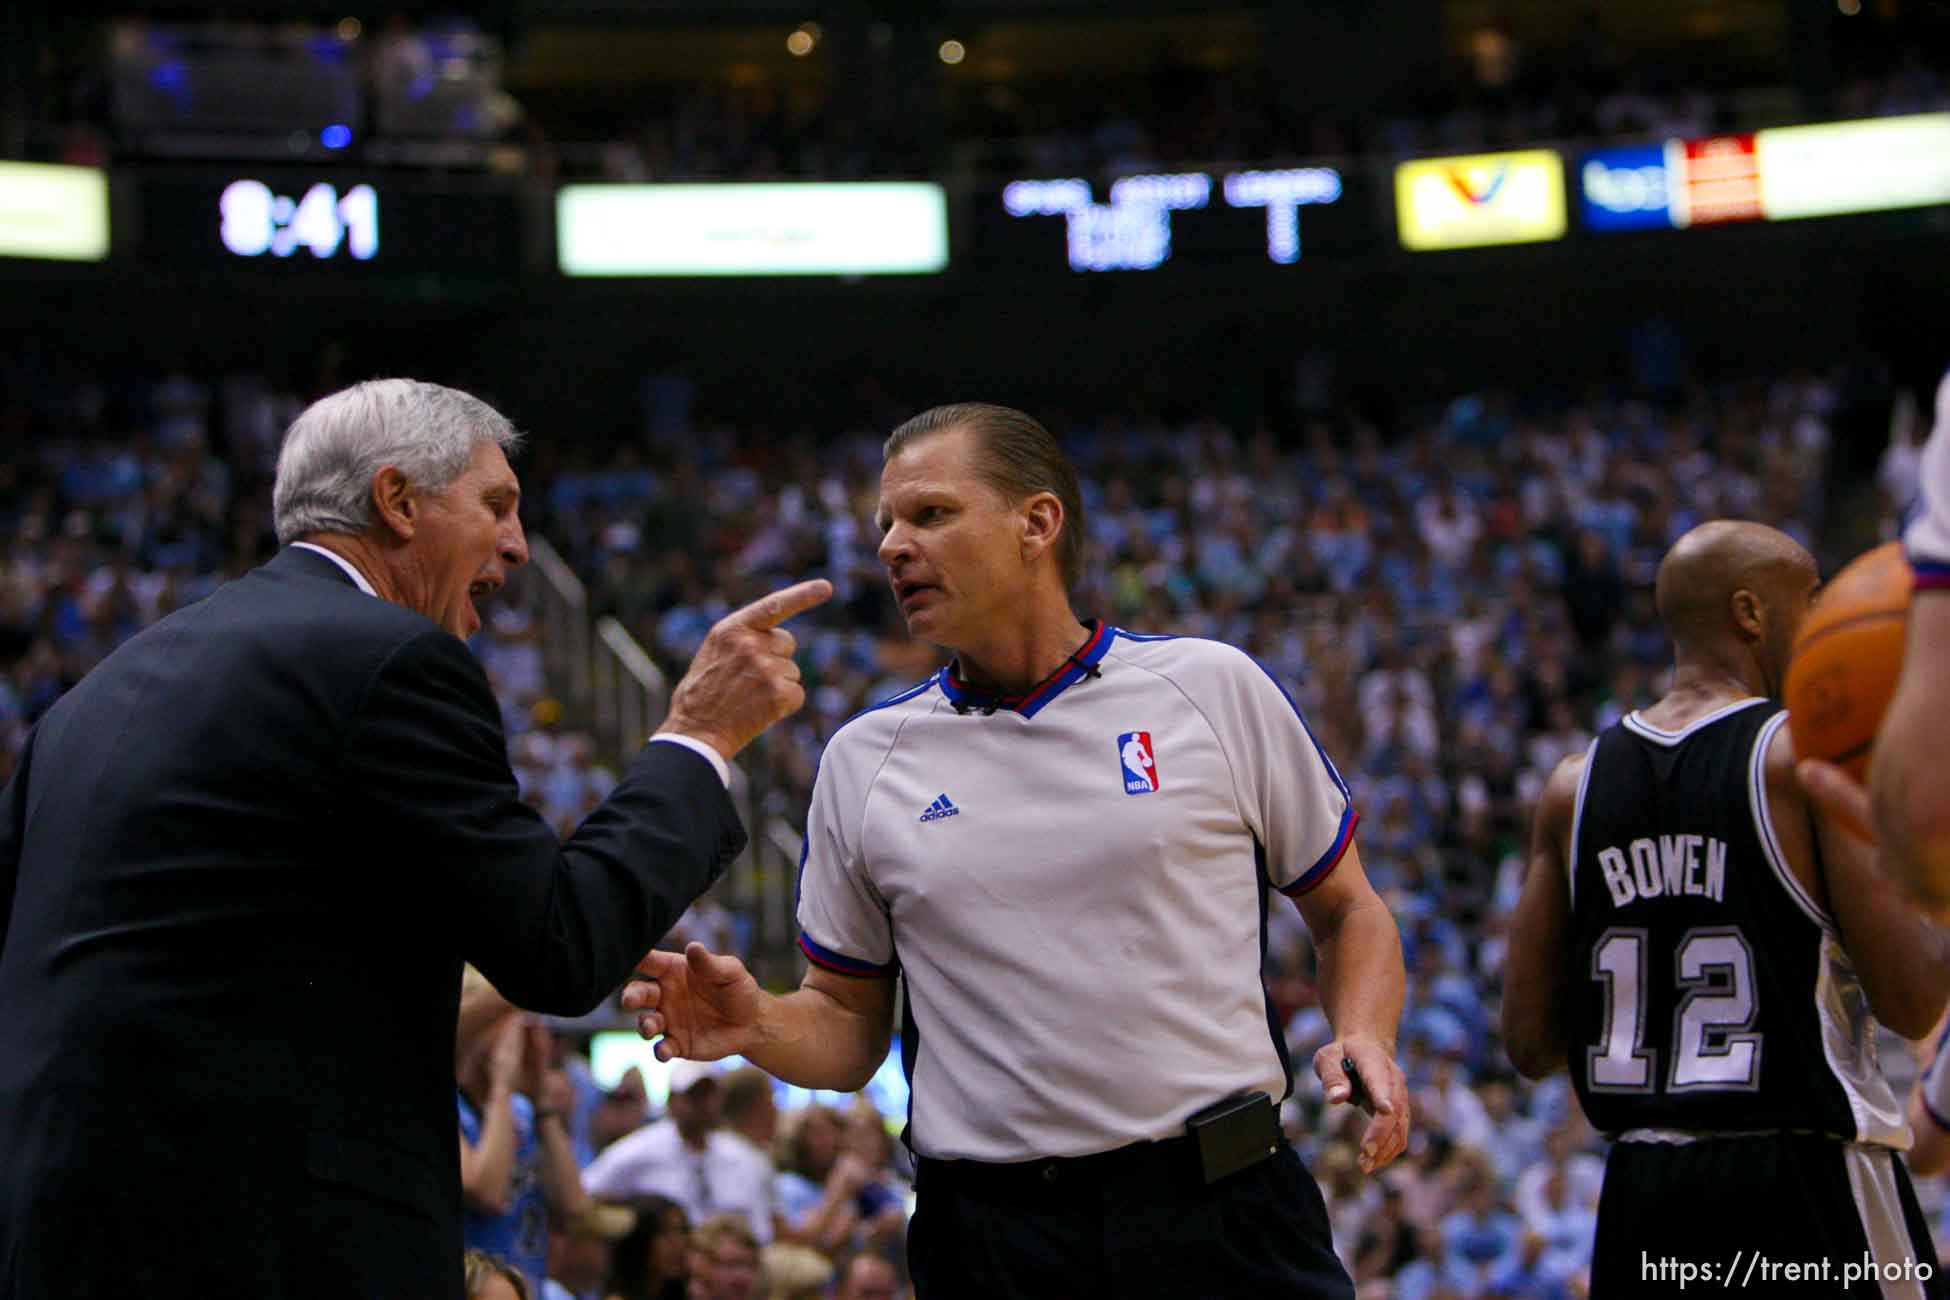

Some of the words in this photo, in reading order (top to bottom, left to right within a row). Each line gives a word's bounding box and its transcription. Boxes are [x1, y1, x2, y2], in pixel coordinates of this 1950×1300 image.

[1126, 780, 1149, 792] NBA
[919, 807, 960, 823] adidas
[1597, 834, 1728, 909] BOWEN
[1587, 926, 1763, 1094] 12
